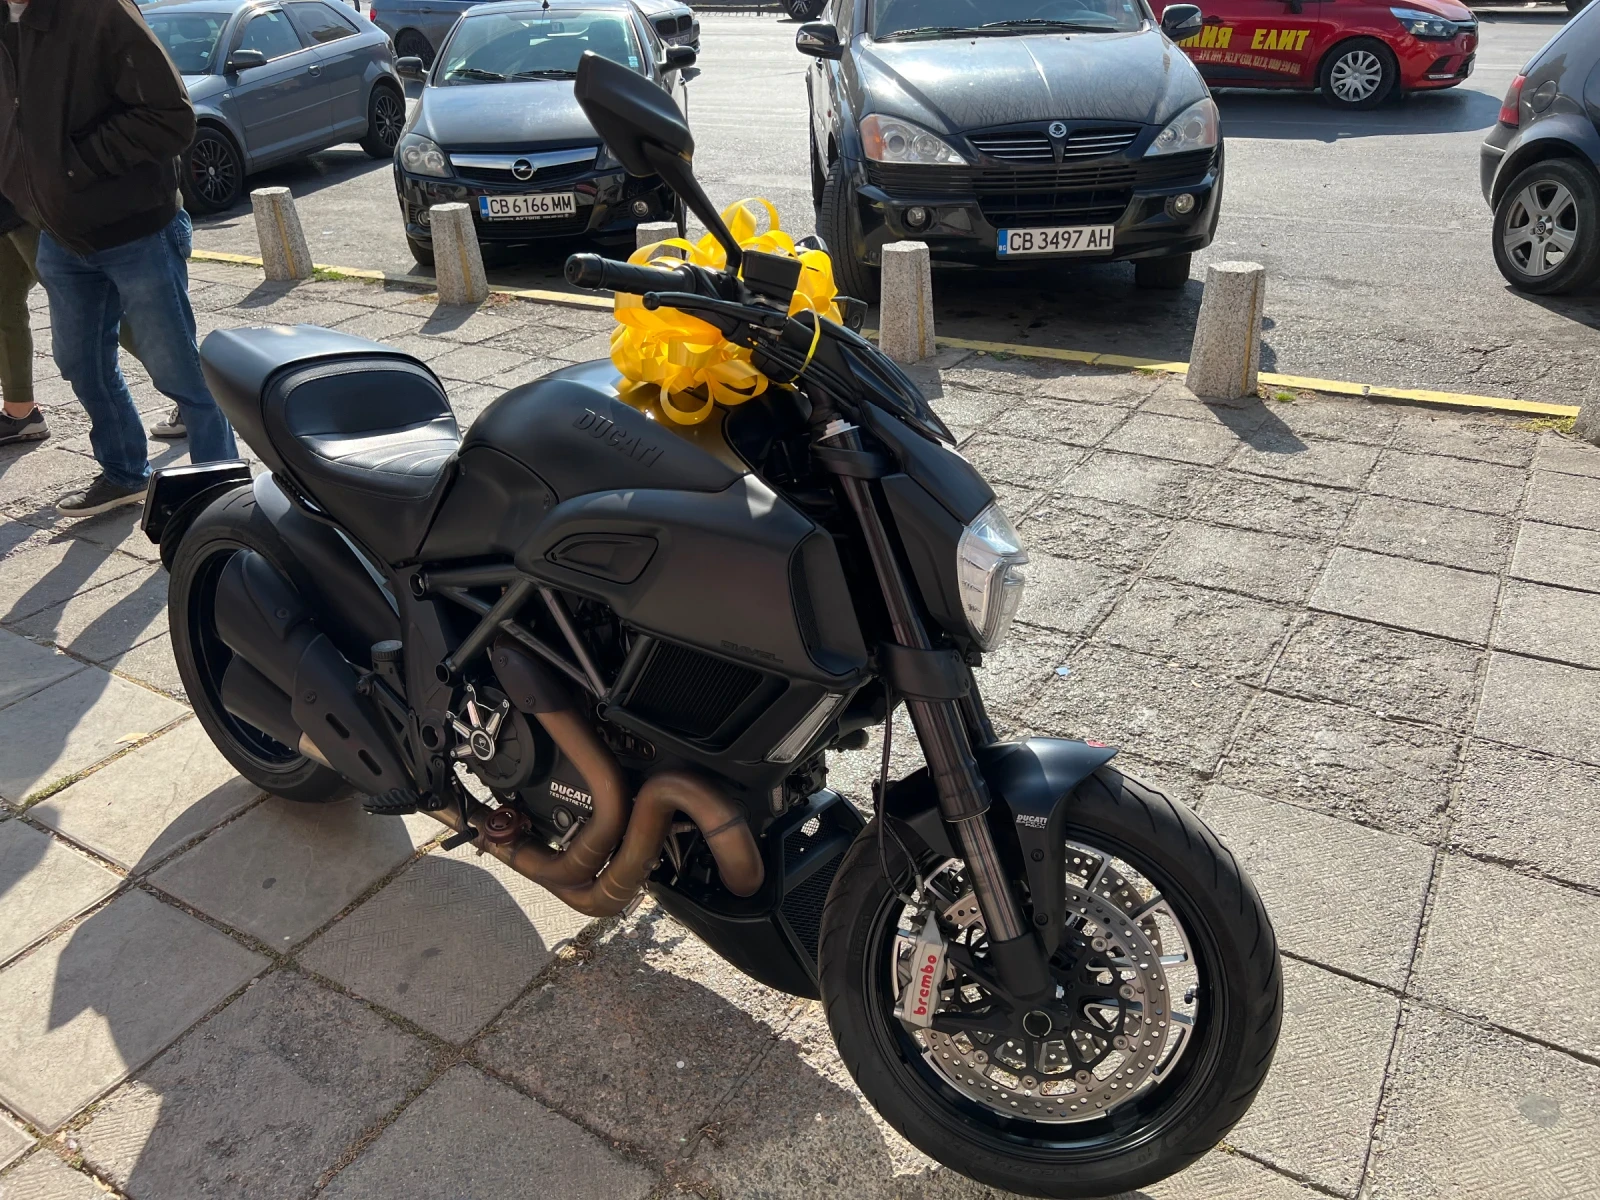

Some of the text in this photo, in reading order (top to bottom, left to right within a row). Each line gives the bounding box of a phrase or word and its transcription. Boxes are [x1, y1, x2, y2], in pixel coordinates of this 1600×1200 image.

[1251, 28, 1310, 51] ЕЛИТ
[573, 408, 665, 468] DUCATI
[550, 781, 592, 805] DUCATI
[1016, 814, 1048, 825] DUCATI
[913, 955, 937, 1016] brembo
